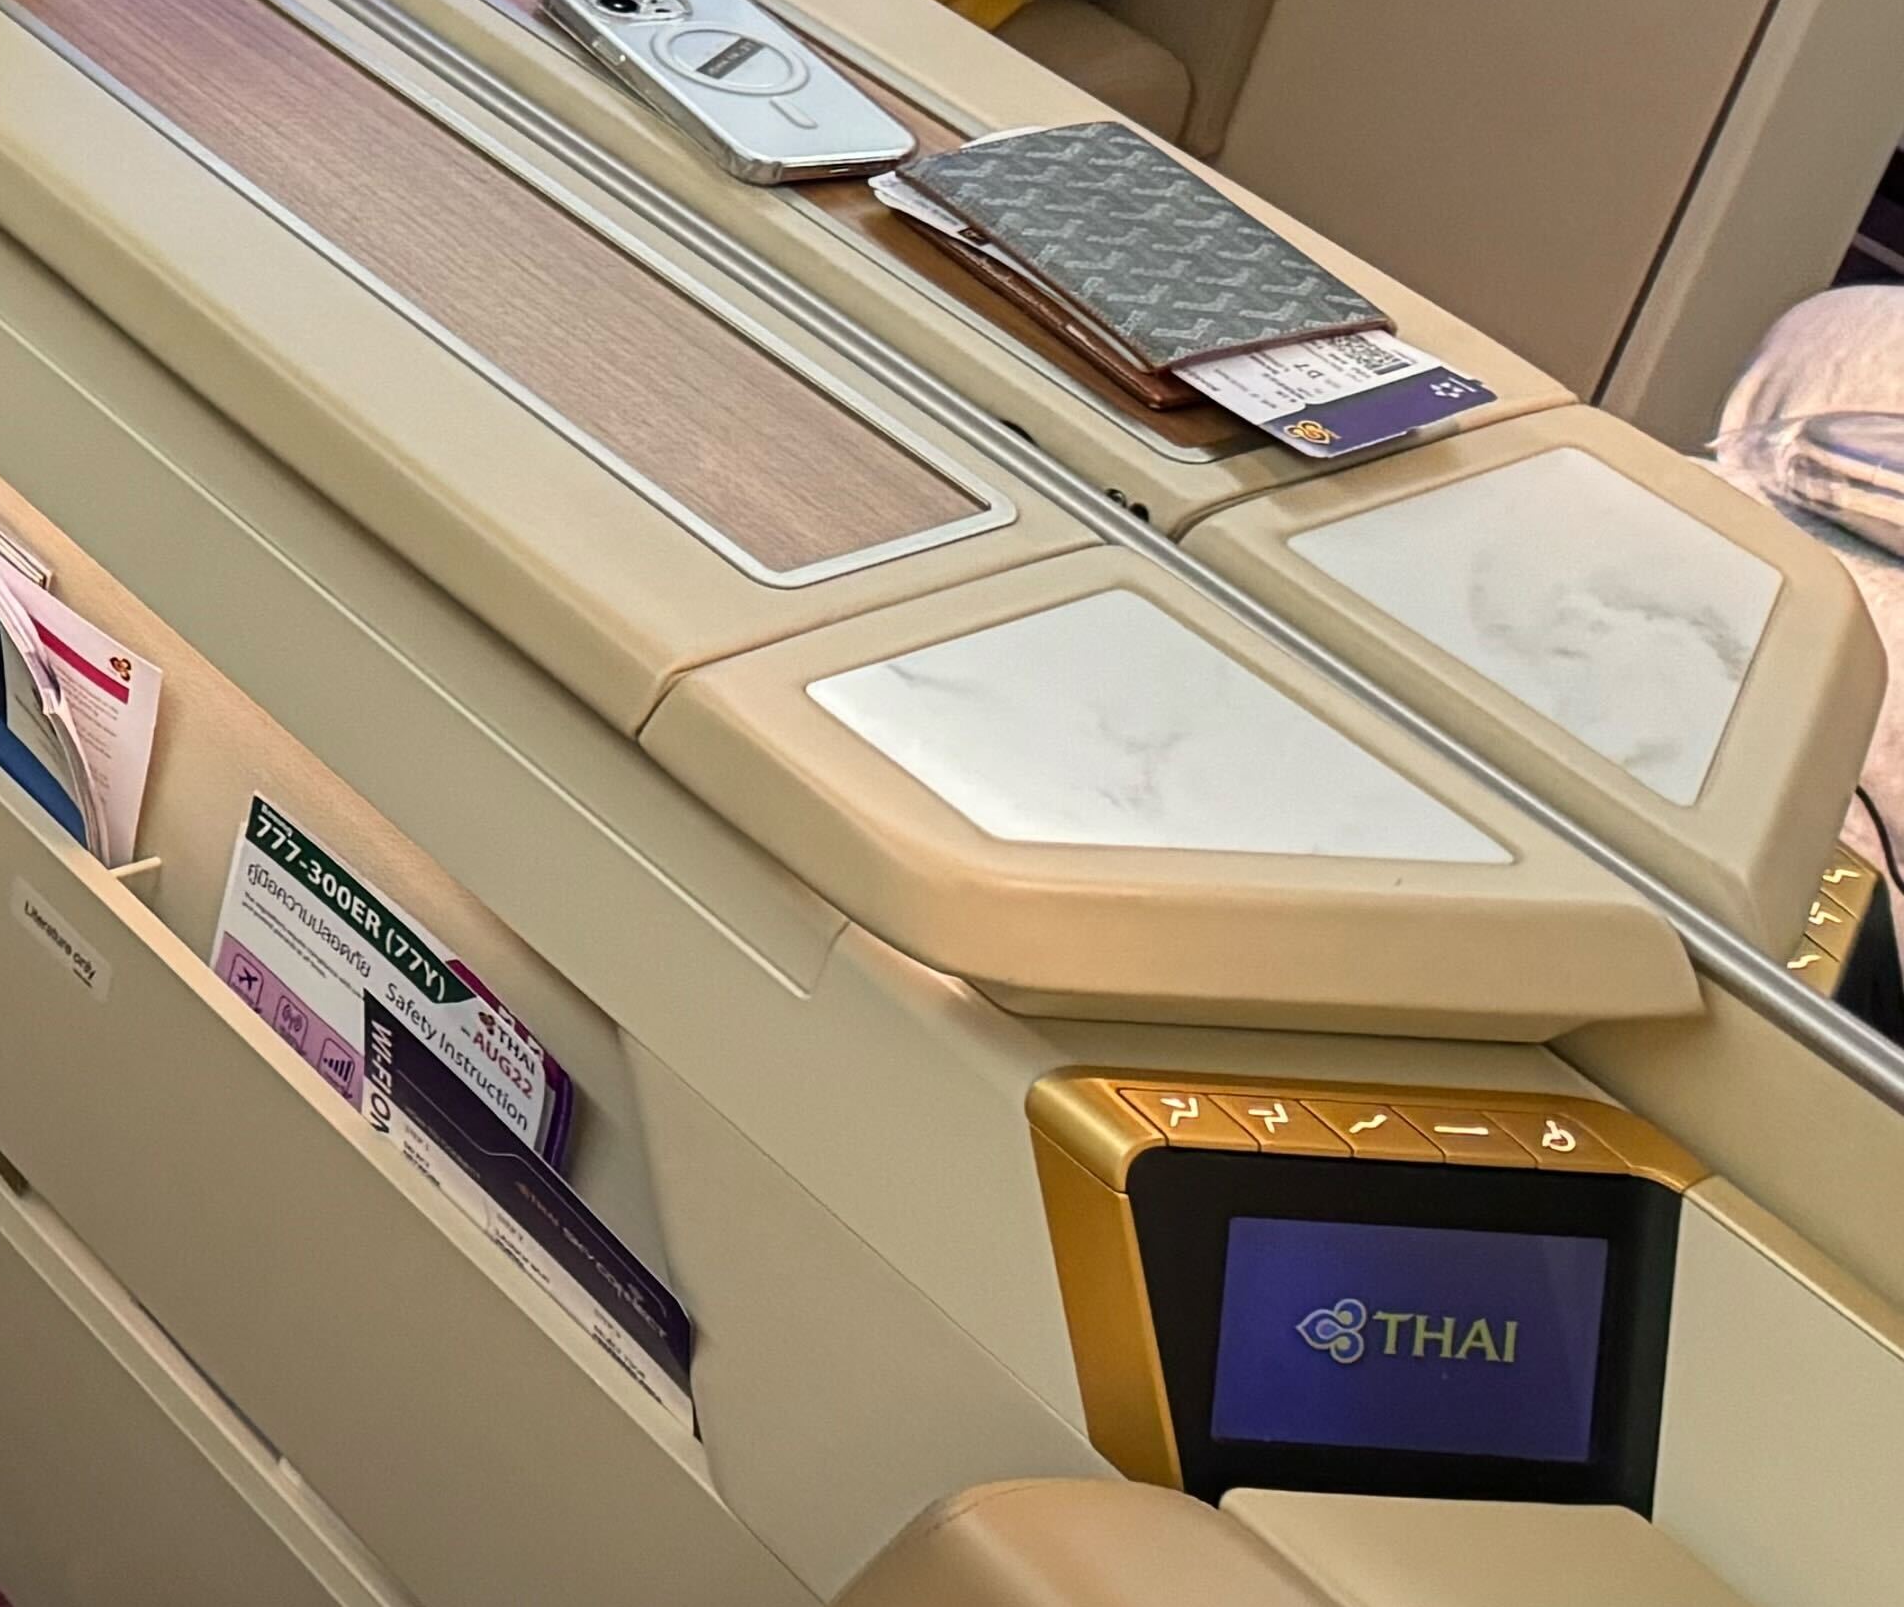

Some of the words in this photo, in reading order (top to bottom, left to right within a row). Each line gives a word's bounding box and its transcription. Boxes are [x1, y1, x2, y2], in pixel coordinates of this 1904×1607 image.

[255, 815, 381, 940] 777-300ER
[385, 928, 446, 1001] (77Y)
[385, 982, 437, 1041] Safety
[439, 1032, 528, 1132] Instruction
[495, 1025, 538, 1076] THAI
[1371, 1309, 1519, 1363] THAI
